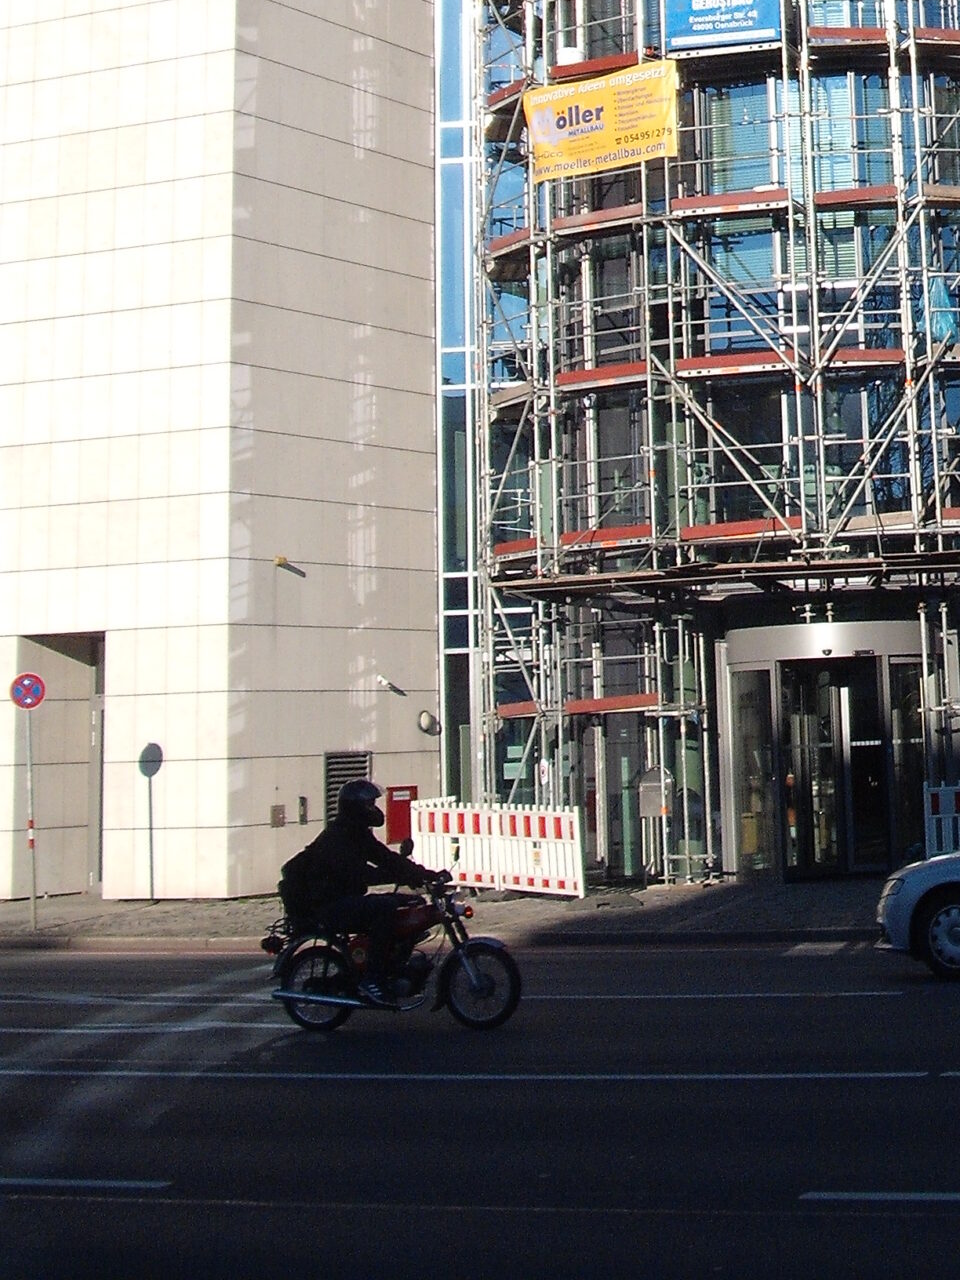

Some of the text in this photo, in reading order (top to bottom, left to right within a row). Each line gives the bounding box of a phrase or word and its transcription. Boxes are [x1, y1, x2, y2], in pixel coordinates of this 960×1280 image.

[609, 67, 665, 86] umgesetzt
[568, 124, 604, 136] METALLBAU
[623, 127, 672, 144] 05495/279
